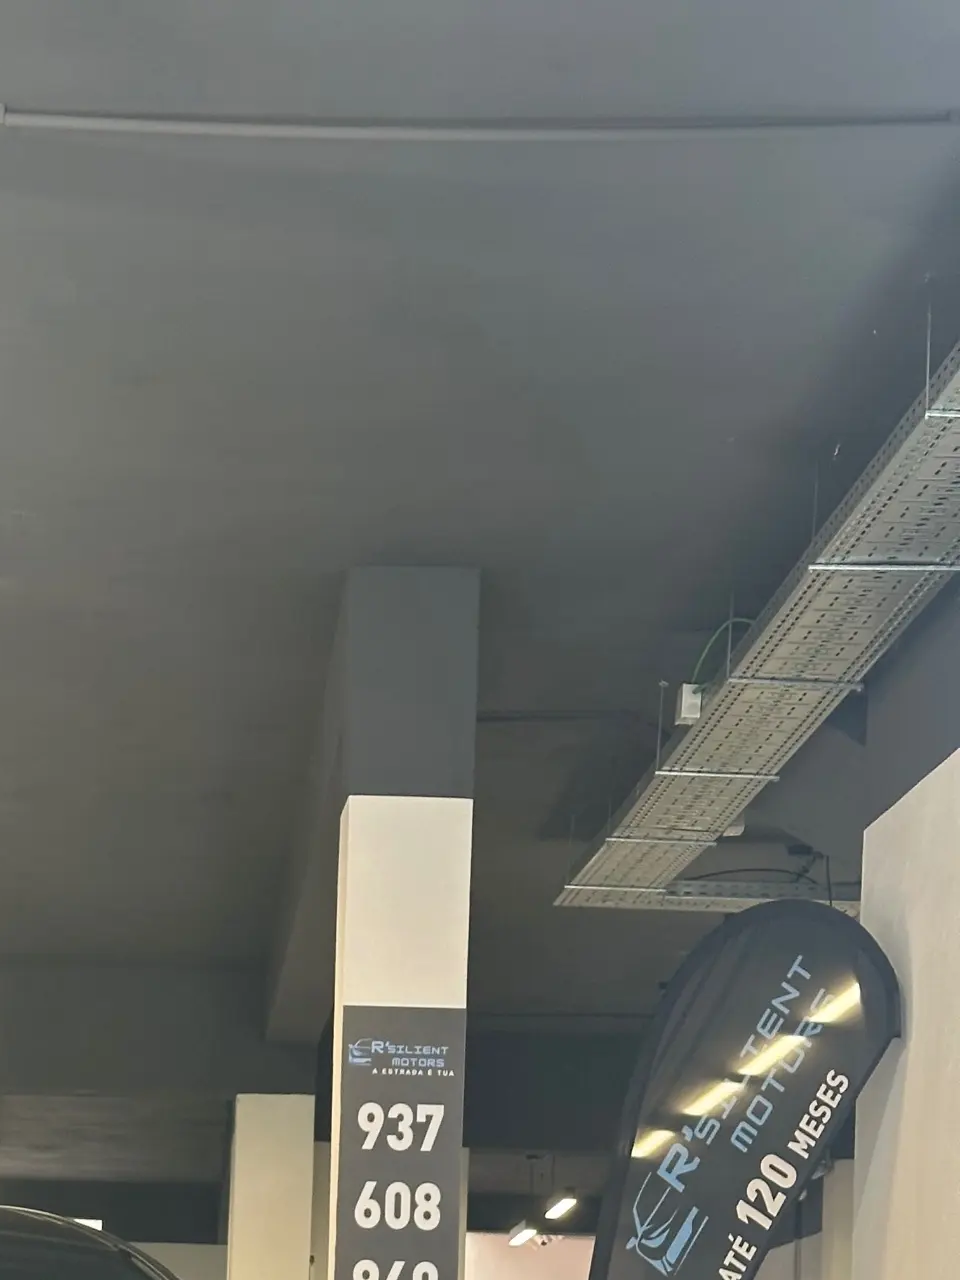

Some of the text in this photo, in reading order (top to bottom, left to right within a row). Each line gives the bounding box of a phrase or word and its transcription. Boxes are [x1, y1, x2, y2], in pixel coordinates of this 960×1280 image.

[371, 1040, 449, 1055] R'SILIENT
[392, 1057, 445, 1067] MOTORS
[382, 1067, 424, 1076] ESTRADA
[437, 1069, 455, 1077] TUA
[357, 1102, 445, 1151] 937
[736, 1152, 798, 1231] 120
[788, 1069, 850, 1160] MESES
[354, 1180, 441, 1231] 608
